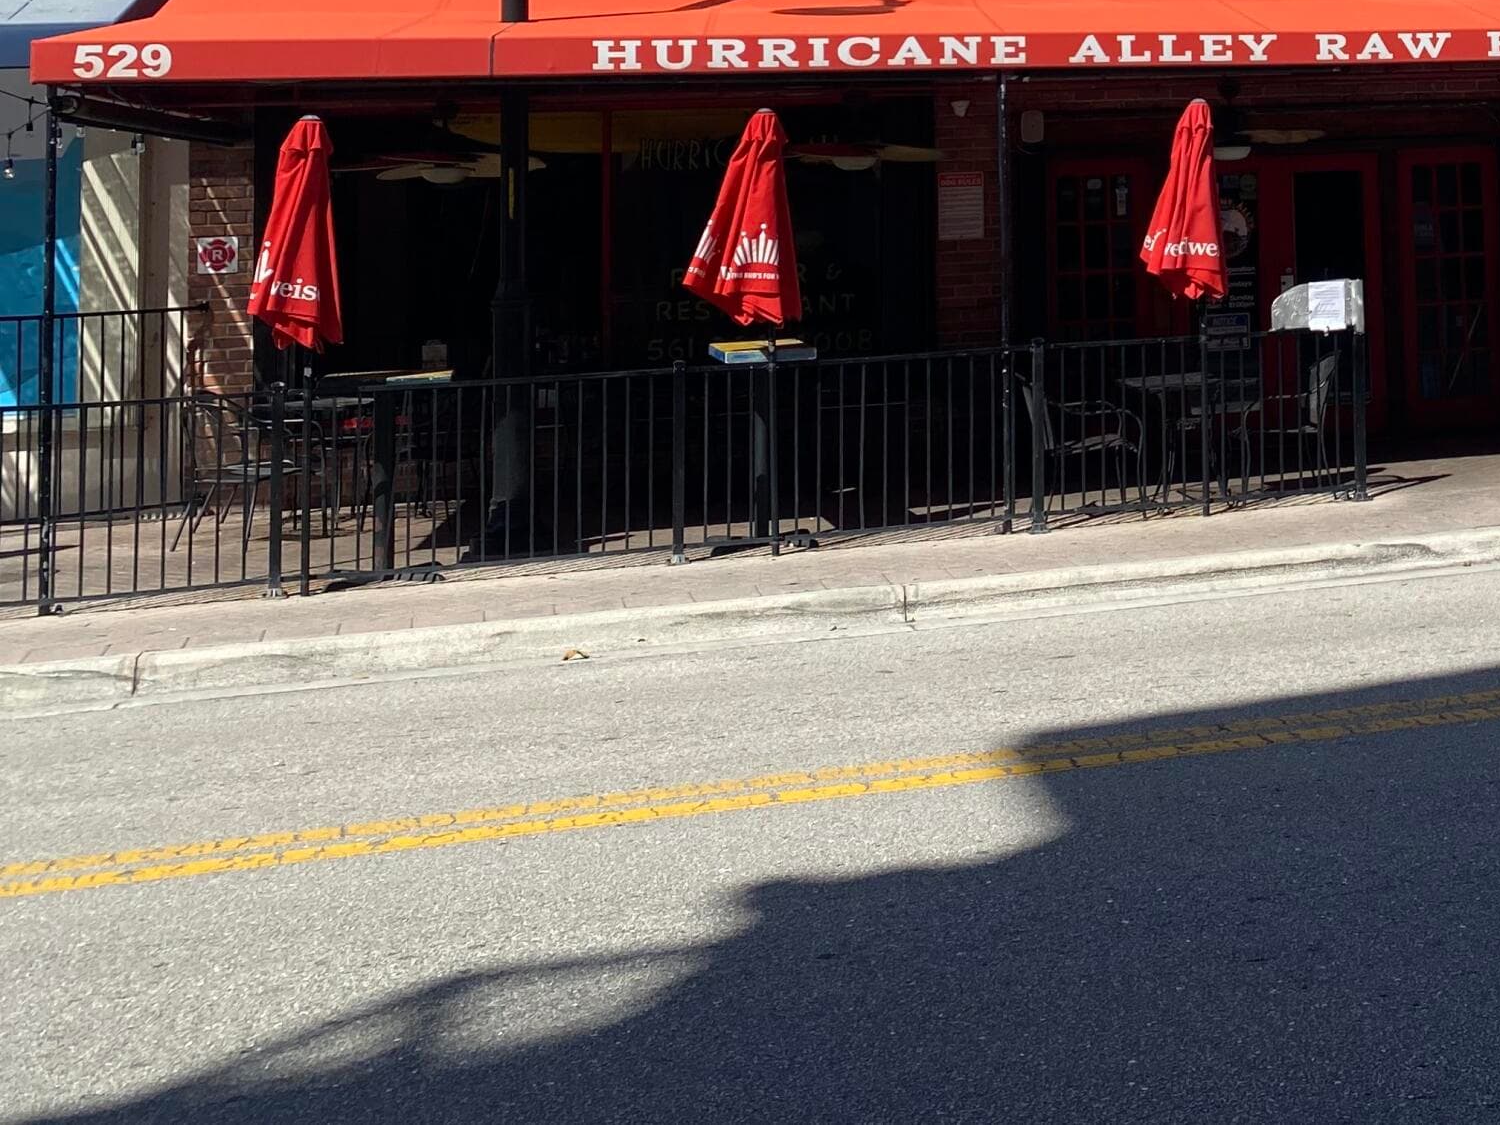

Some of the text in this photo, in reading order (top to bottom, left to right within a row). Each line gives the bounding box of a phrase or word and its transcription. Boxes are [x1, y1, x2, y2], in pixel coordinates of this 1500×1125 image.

[72, 43, 173, 78] 529
[592, 36, 1027, 72] HURRICANE
[1069, 34, 1278, 65] ALLEY
[1316, 32, 1453, 62] RAW
[641, 138, 728, 172] HURRIC
[212, 249, 224, 262] R
